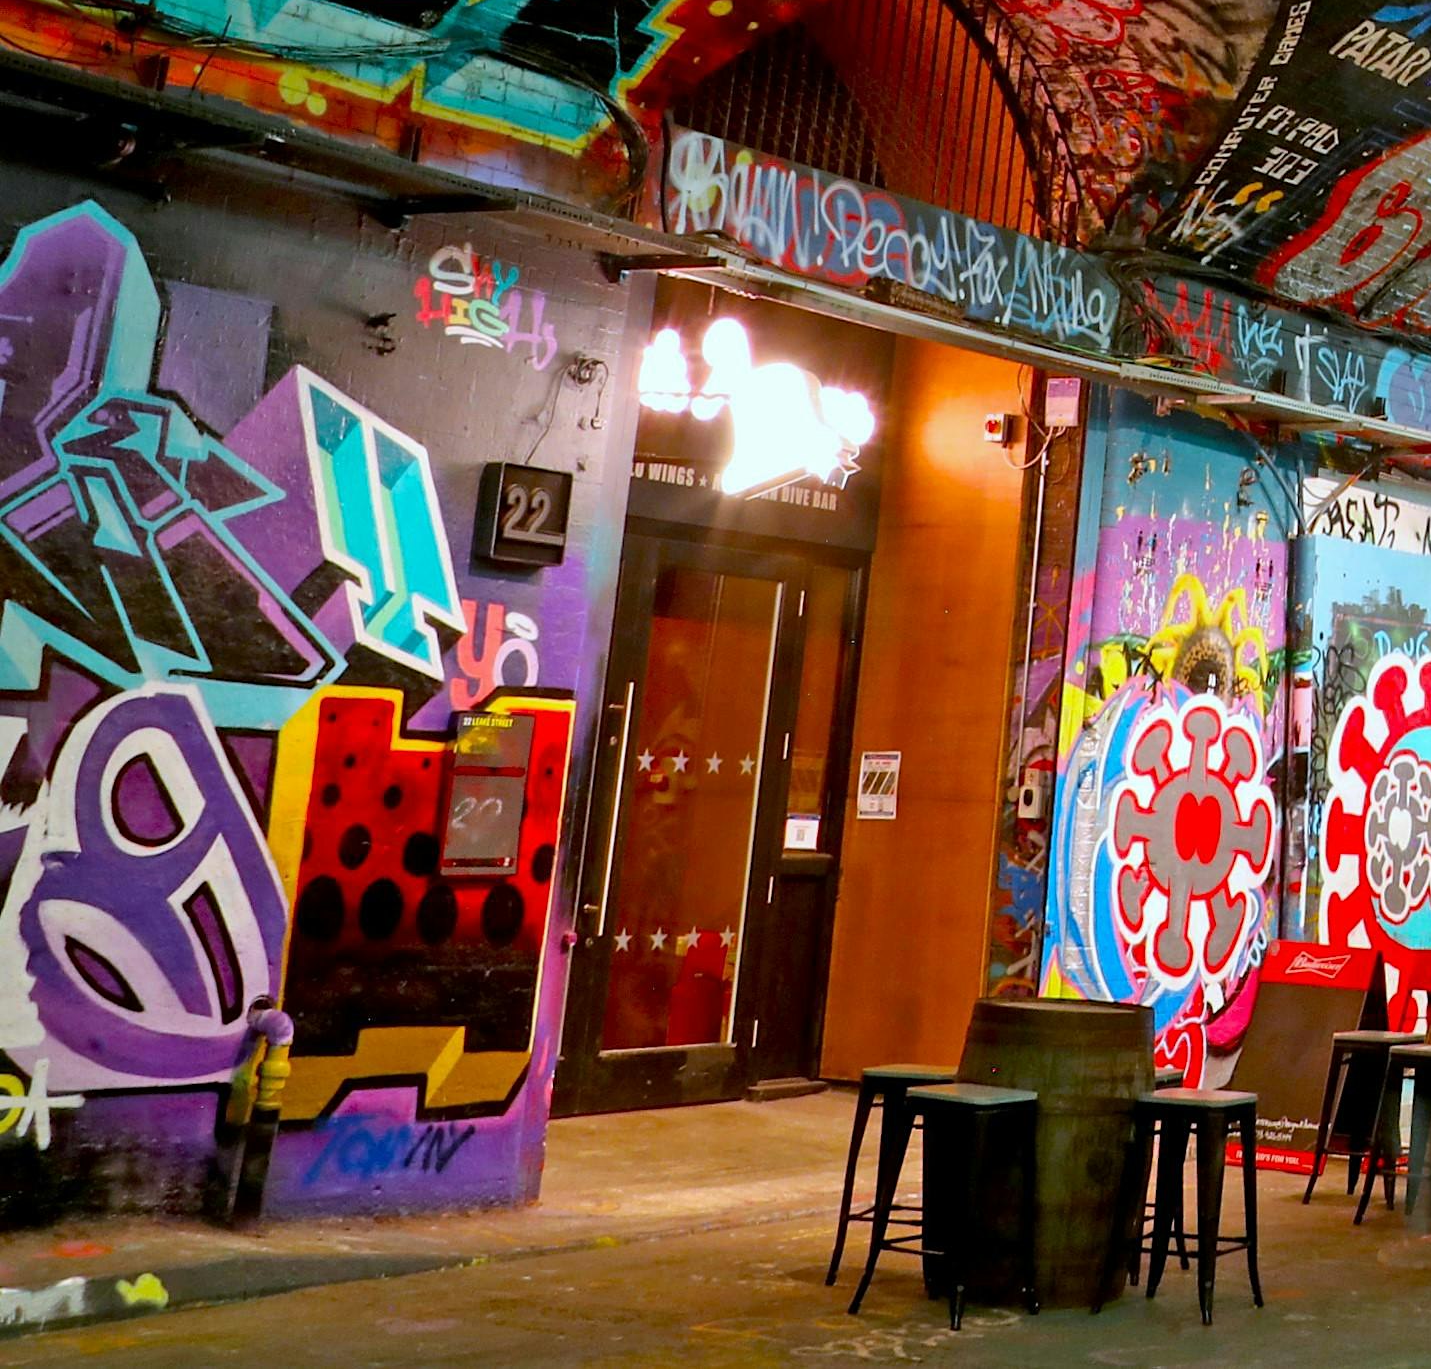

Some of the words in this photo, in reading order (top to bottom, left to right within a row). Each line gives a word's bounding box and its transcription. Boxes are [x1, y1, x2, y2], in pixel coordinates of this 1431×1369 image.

[504, 484, 552, 534] 22
[649, 463, 695, 487] WINGS
[780, 485, 809, 506] DIVE
[812, 488, 837, 511] BAR
